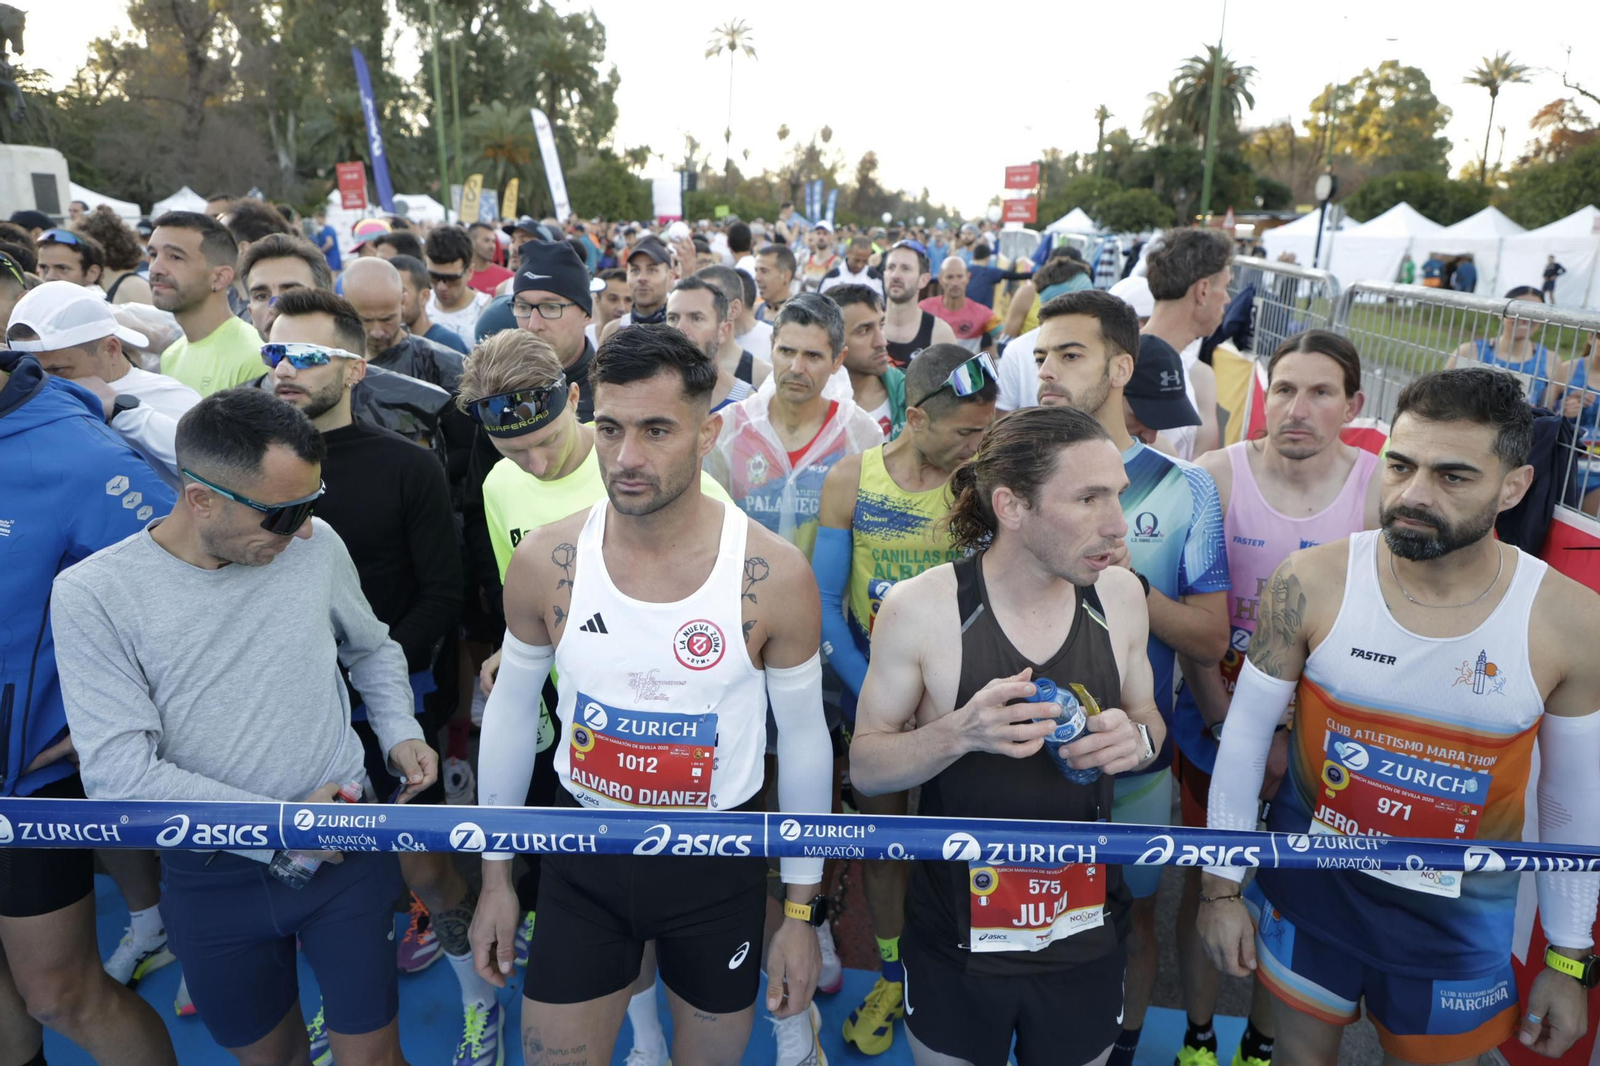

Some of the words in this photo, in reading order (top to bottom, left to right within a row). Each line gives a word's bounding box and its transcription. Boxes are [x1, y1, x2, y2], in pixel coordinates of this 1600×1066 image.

[745, 495, 820, 514] PALAIEG
[1233, 535, 1265, 548] FASTER
[871, 548, 941, 564] CANILLAS
[873, 563, 936, 581] ALBA
[683, 624, 709, 637] NUEVA
[710, 631, 720, 653] ZONA
[1350, 647, 1397, 666] FASTER
[616, 717, 698, 738] ZURICH
[1326, 717, 1351, 736] CLUB
[1354, 729, 1424, 753] ATLETISMO
[1426, 743, 1498, 767] MARATHON
[617, 752, 659, 773] 1012
[571, 767, 633, 802] ALVARO
[638, 788, 708, 806] DIANEZ
[1378, 759, 1467, 795] ZURICH
[1377, 797, 1413, 821] 971
[192, 823, 268, 846] asics
[318, 833, 377, 845] MARATÓN
[671, 834, 752, 857] asics
[804, 845, 865, 857] MARATÓN
[1179, 845, 1260, 867] asics
[1317, 855, 1381, 870] MARATÓN
[1029, 879, 1061, 894] 575
[1012, 890, 1068, 927] JUJU
[1440, 987, 1509, 1011] MARCHENA
[1457, 990, 1487, 998] ATLETISMO
